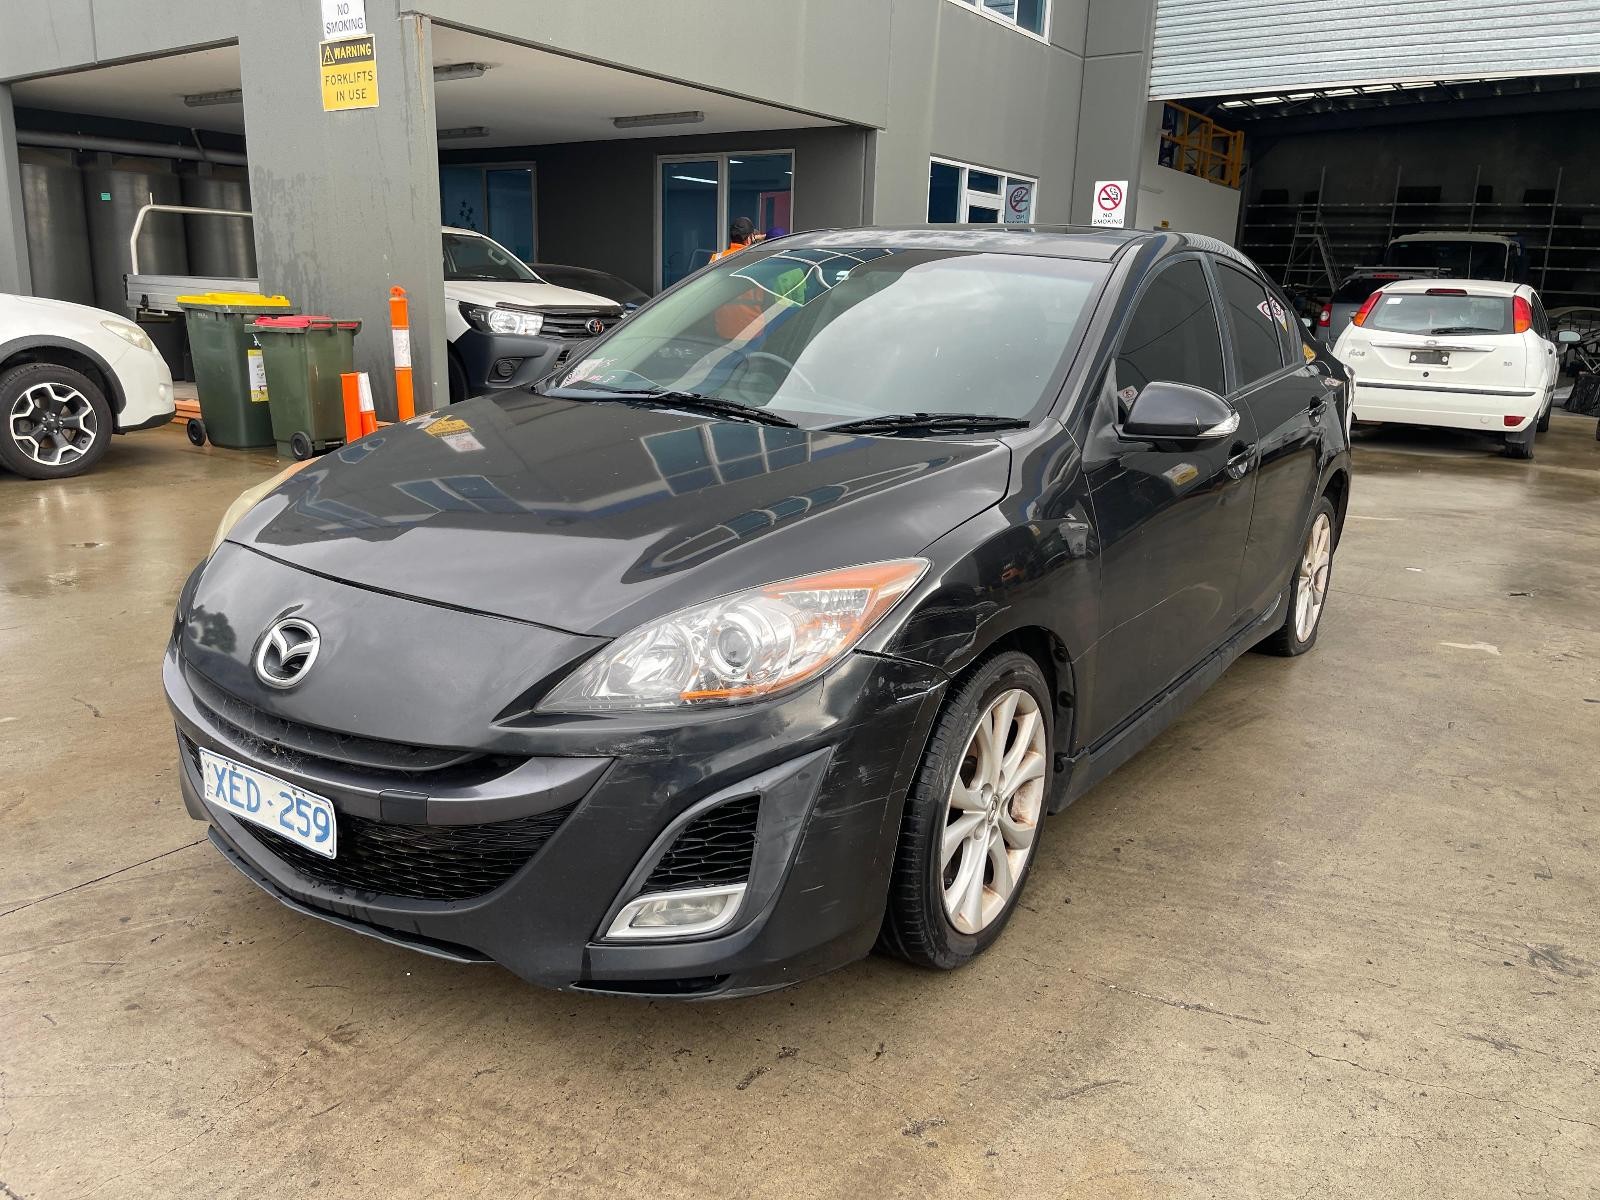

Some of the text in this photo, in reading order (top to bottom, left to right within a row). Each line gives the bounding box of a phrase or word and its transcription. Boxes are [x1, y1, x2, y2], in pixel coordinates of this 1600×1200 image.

[337, 3, 349, 16] NO
[326, 17, 364, 34] SMOKING
[333, 43, 372, 60] WARNING
[325, 70, 373, 86] FORKLIFTS
[336, 88, 367, 102] IN USE
